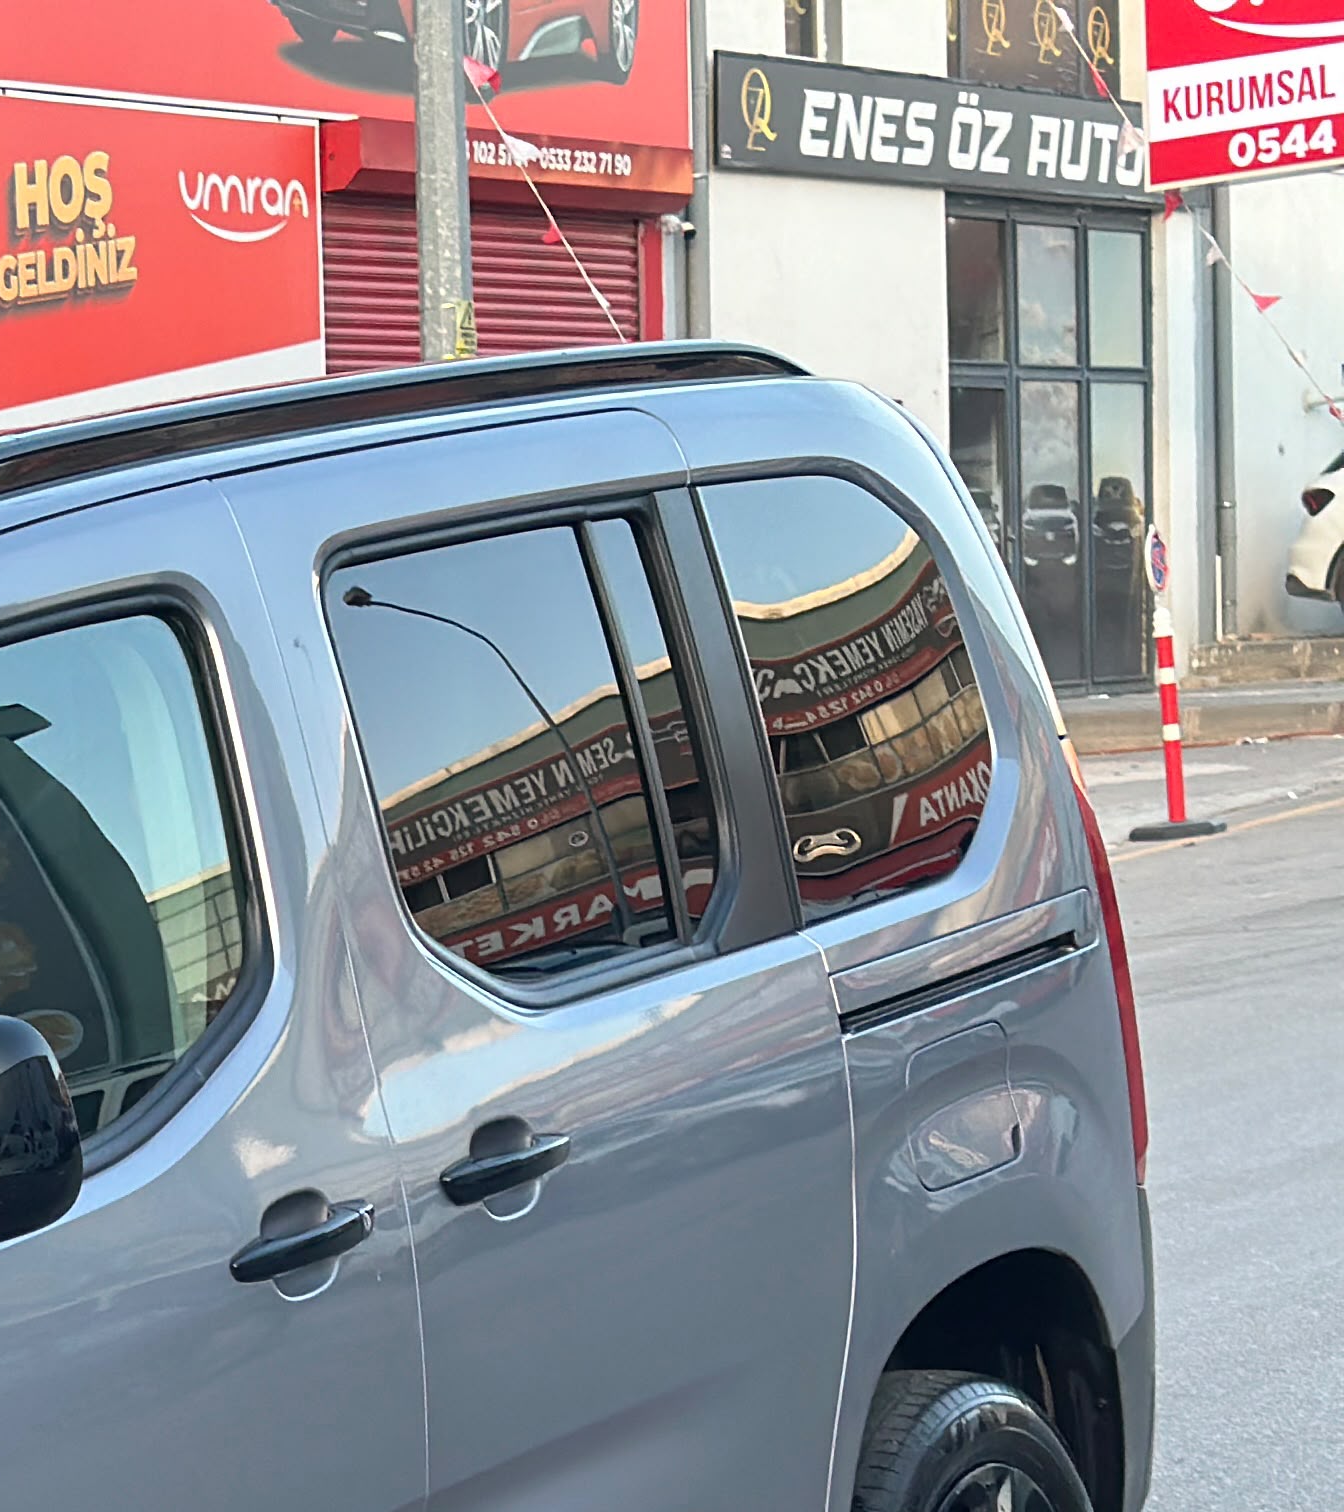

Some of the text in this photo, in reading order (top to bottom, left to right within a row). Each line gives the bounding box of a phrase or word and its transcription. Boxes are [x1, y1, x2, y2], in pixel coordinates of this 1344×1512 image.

[1162, 65, 1336, 123] KURUMSAL
[573, 150, 596, 174] 232
[599, 152, 613, 175] 71
[614, 153, 632, 177] 90
[799, 88, 938, 166] ENES
[948, 91, 1012, 174] ÖZ
[1026, 114, 1143, 188] AUTO
[1228, 120, 1336, 168] 0544
[13, 150, 113, 238] HOŞ
[178, 169, 309, 218] umran
